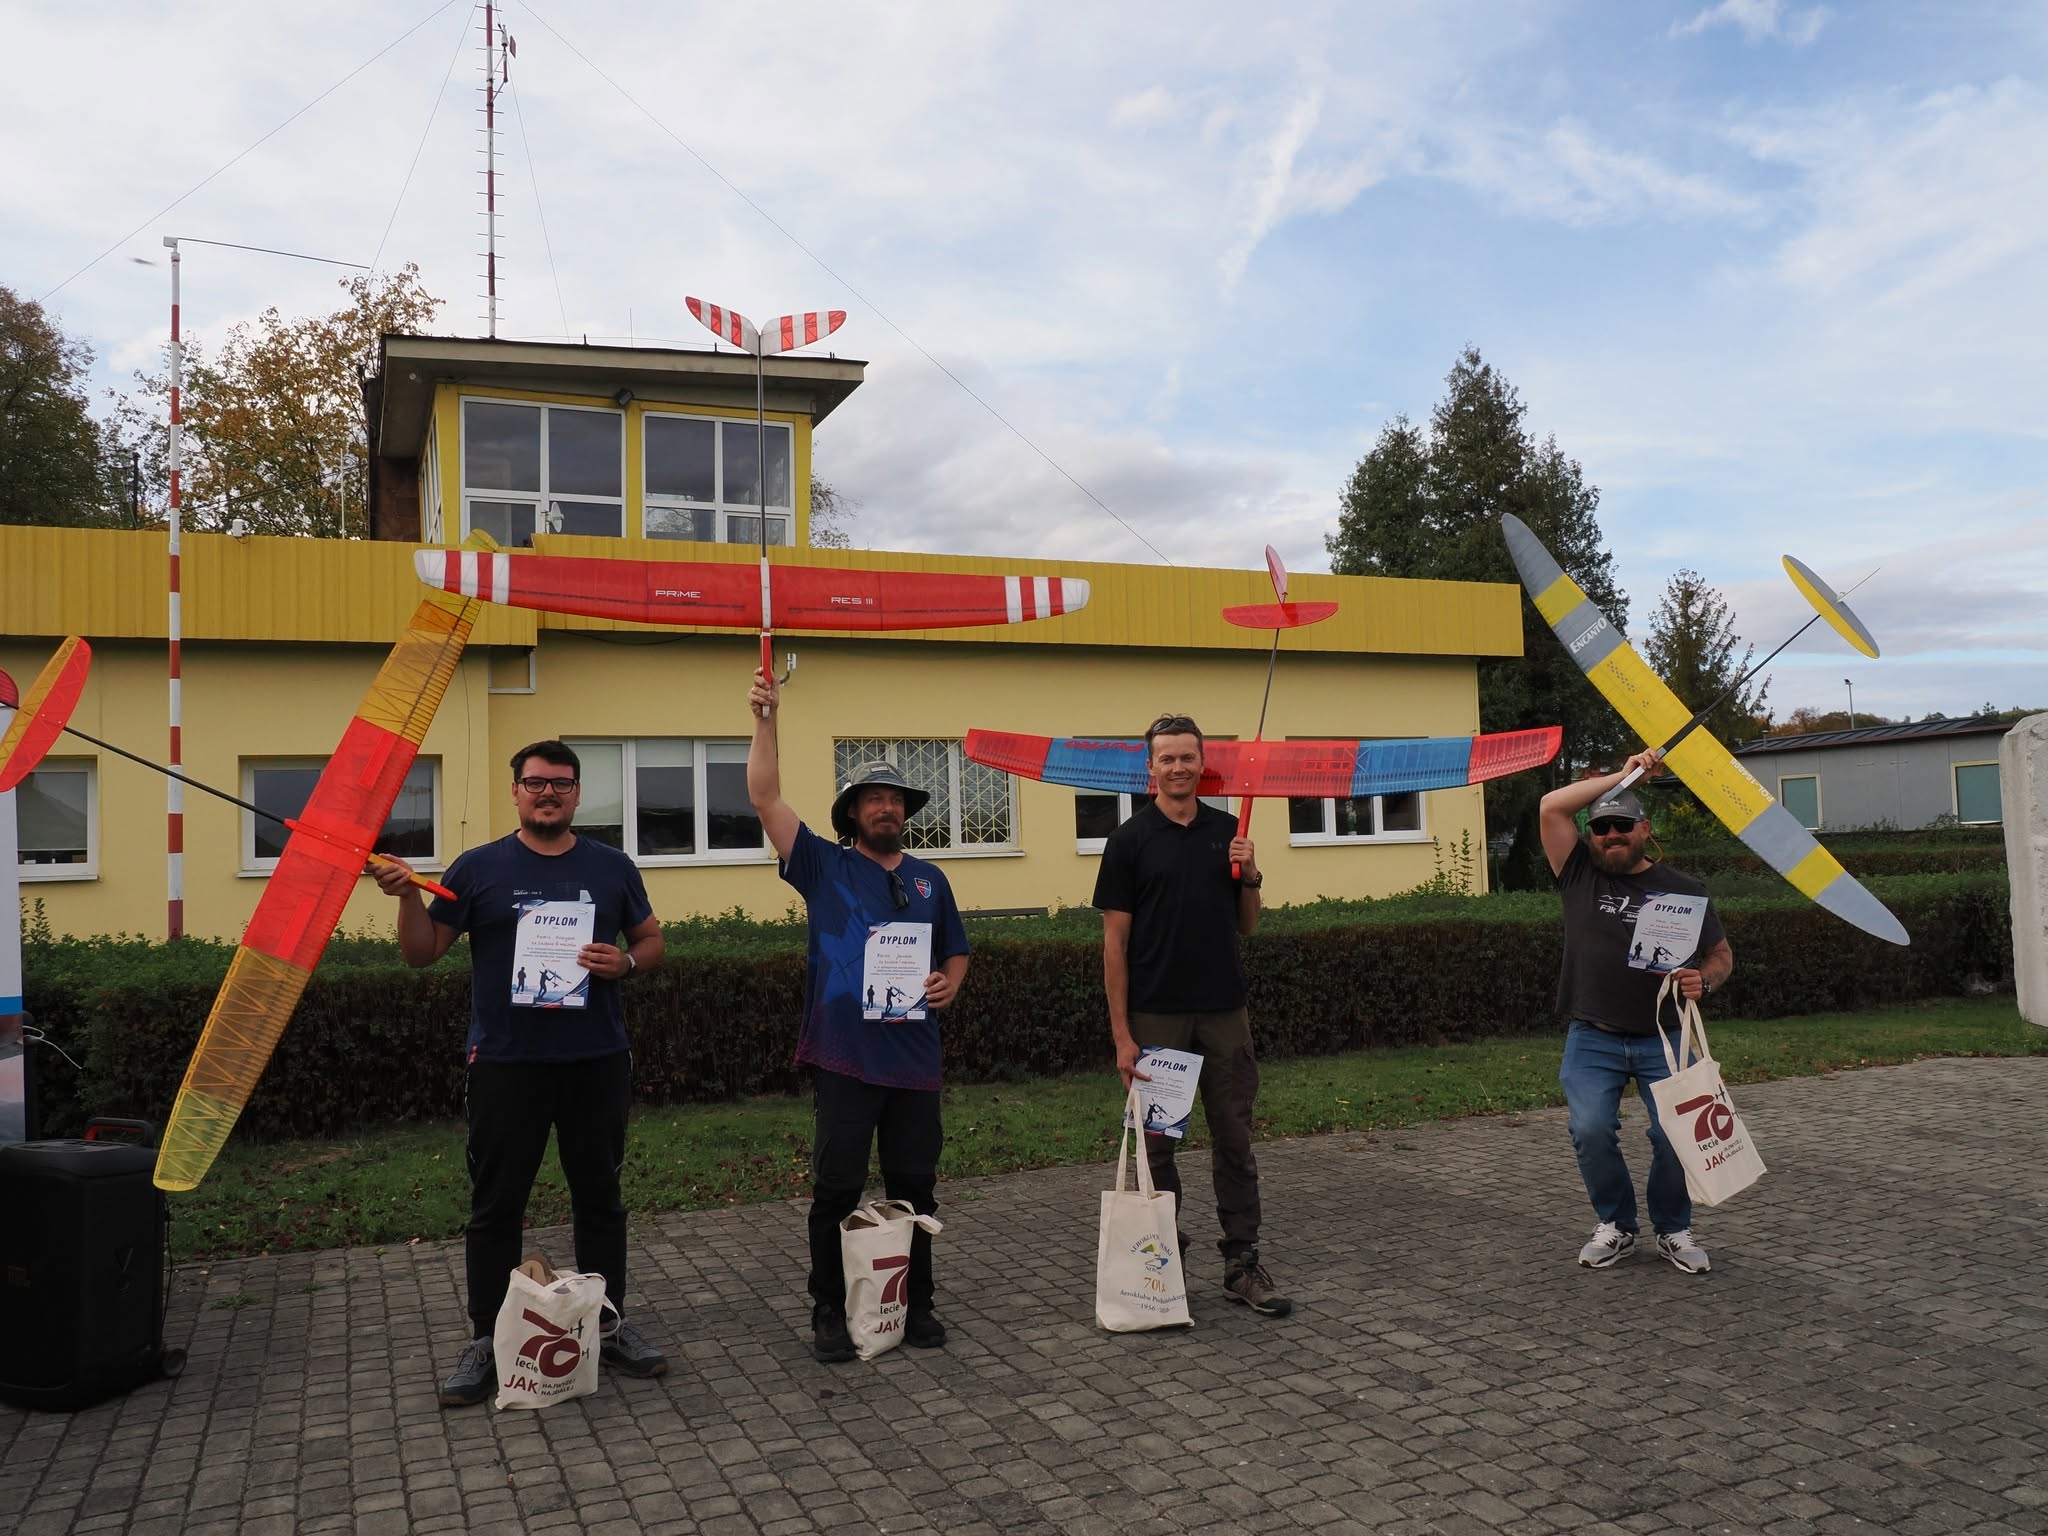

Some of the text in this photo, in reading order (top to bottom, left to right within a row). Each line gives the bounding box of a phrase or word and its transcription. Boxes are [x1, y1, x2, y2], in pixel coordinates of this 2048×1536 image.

[831, 596, 862, 605] RES
[1569, 616, 1607, 654] ENCANTO
[1600, 904, 1617, 914] F3K
[1654, 903, 1693, 915] DYPLOM
[534, 915, 578, 927] DYPLOM
[880, 935, 917, 945] DYPLOM
[1150, 1058, 1188, 1073] DYPLOM
[1697, 1138, 1720, 1152] lecie
[1704, 1151, 1727, 1171] JAK
[880, 1303, 900, 1315] lecie
[874, 1317, 900, 1334] JAK
[515, 1356, 539, 1374] lecie
[504, 1374, 539, 1394] JAK
